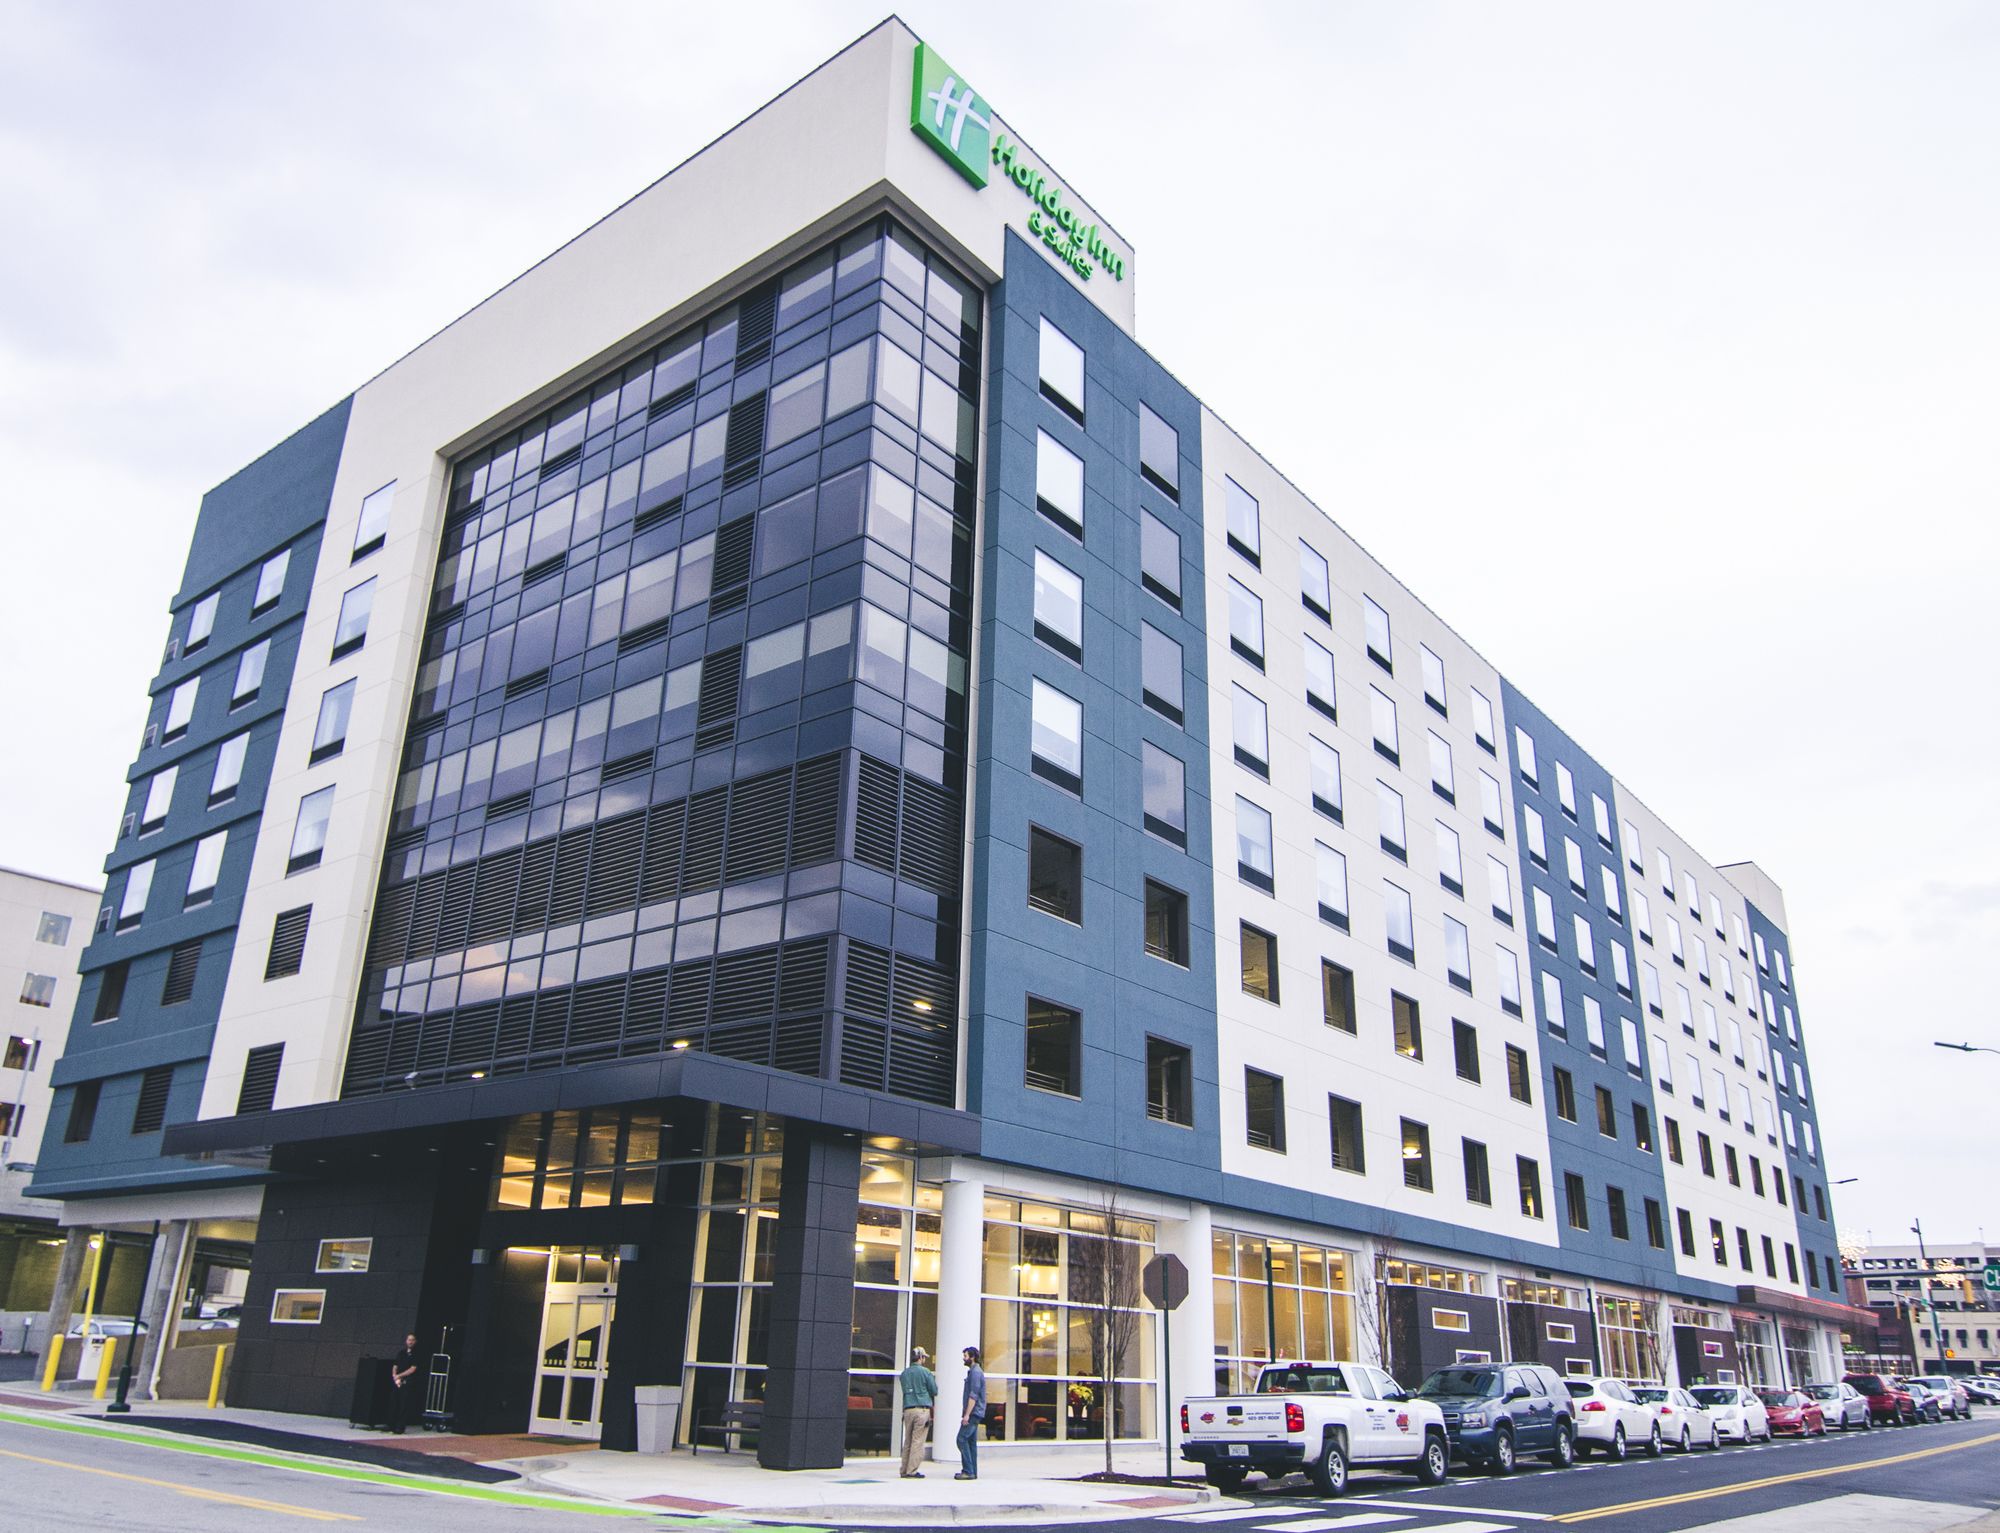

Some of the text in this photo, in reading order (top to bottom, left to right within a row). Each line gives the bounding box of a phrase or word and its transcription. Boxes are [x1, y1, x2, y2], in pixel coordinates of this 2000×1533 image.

[992, 134, 1125, 281] Holiday Inn
[1027, 210, 1093, 281] & Suites
